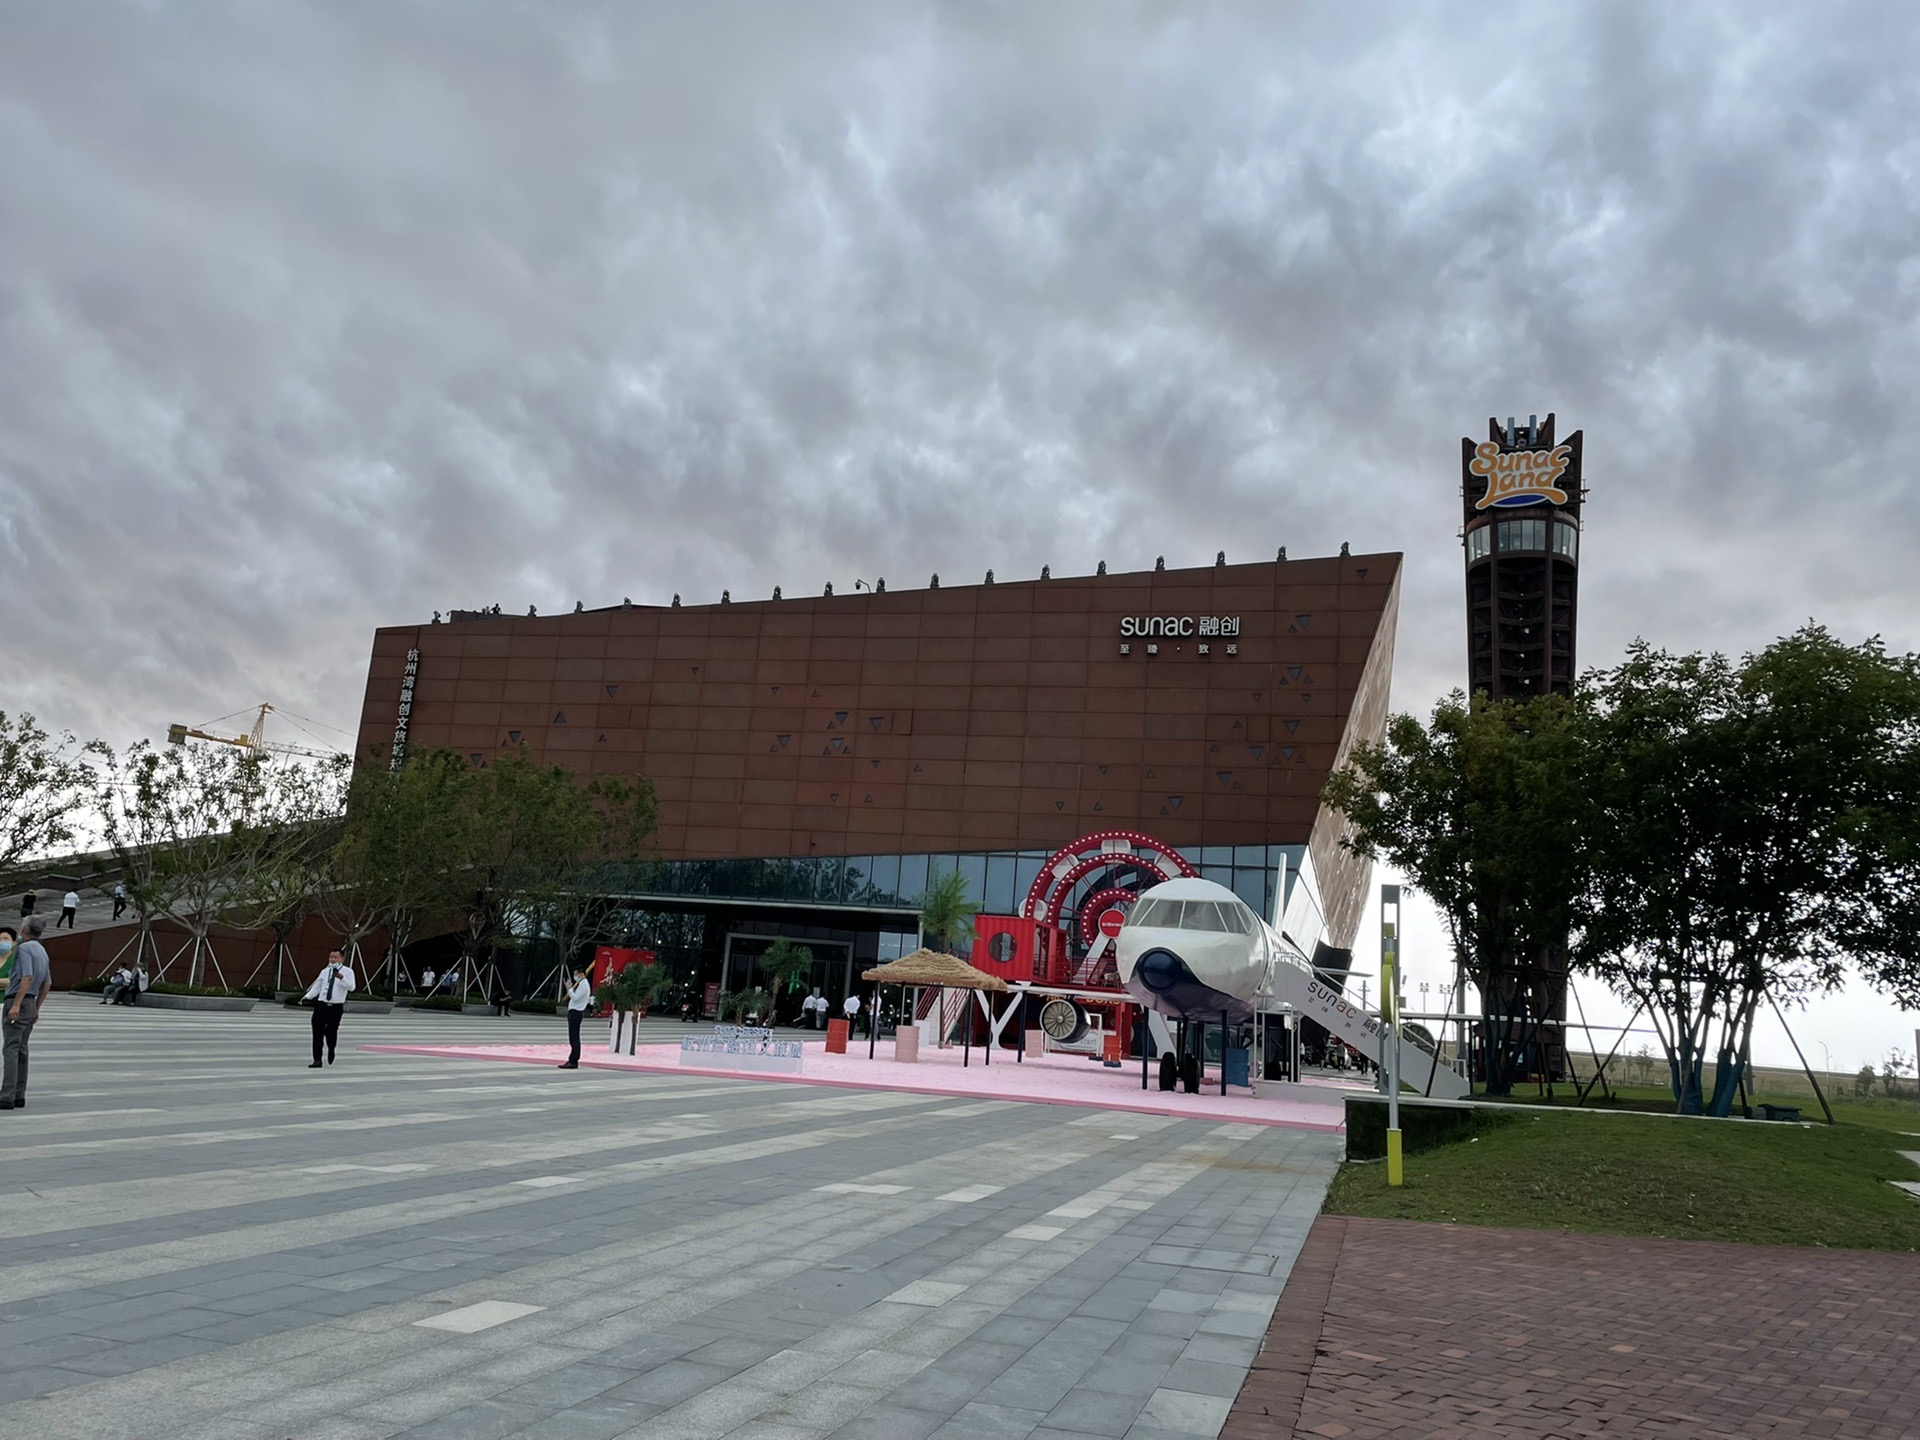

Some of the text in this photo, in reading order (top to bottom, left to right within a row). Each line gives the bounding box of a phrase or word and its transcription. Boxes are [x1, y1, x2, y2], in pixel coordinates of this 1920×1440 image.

[1470, 442, 1572, 475] Sunac
[1476, 467, 1568, 509] Land
[1120, 616, 1240, 636] sunac 融创
[1307, 981, 1357, 1019] sunac
